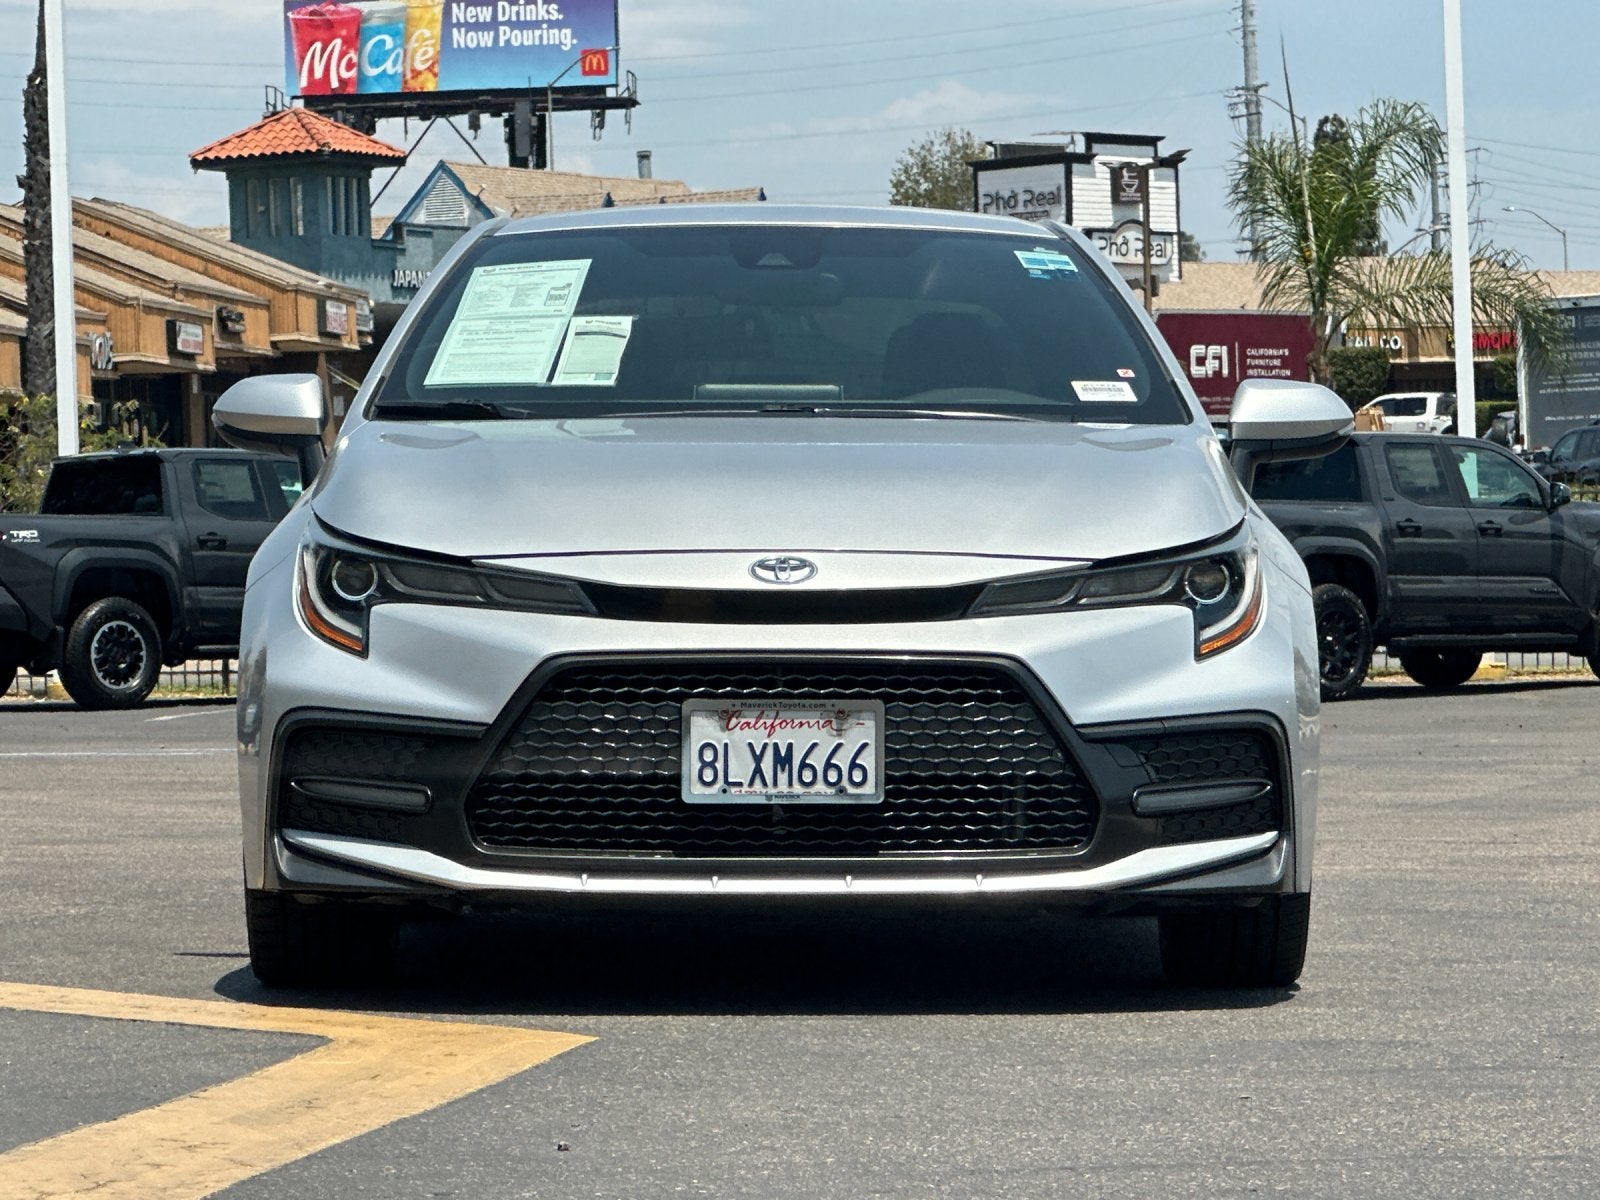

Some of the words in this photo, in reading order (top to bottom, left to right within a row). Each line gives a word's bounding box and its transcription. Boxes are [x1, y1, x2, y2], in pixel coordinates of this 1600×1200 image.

[452, 3, 492, 23] New
[497, 0, 563, 22] Drinks.
[452, 28, 494, 48] Now
[499, 23, 578, 50] Pouring.
[1022, 184, 1061, 208] Real
[1190, 345, 1229, 378] CFI
[1246, 348, 1289, 356] CALIFORNIA'S
[10, 530, 38, 538] TRD
[725, 710, 849, 738] California
[697, 742, 870, 787] 8LXM666
